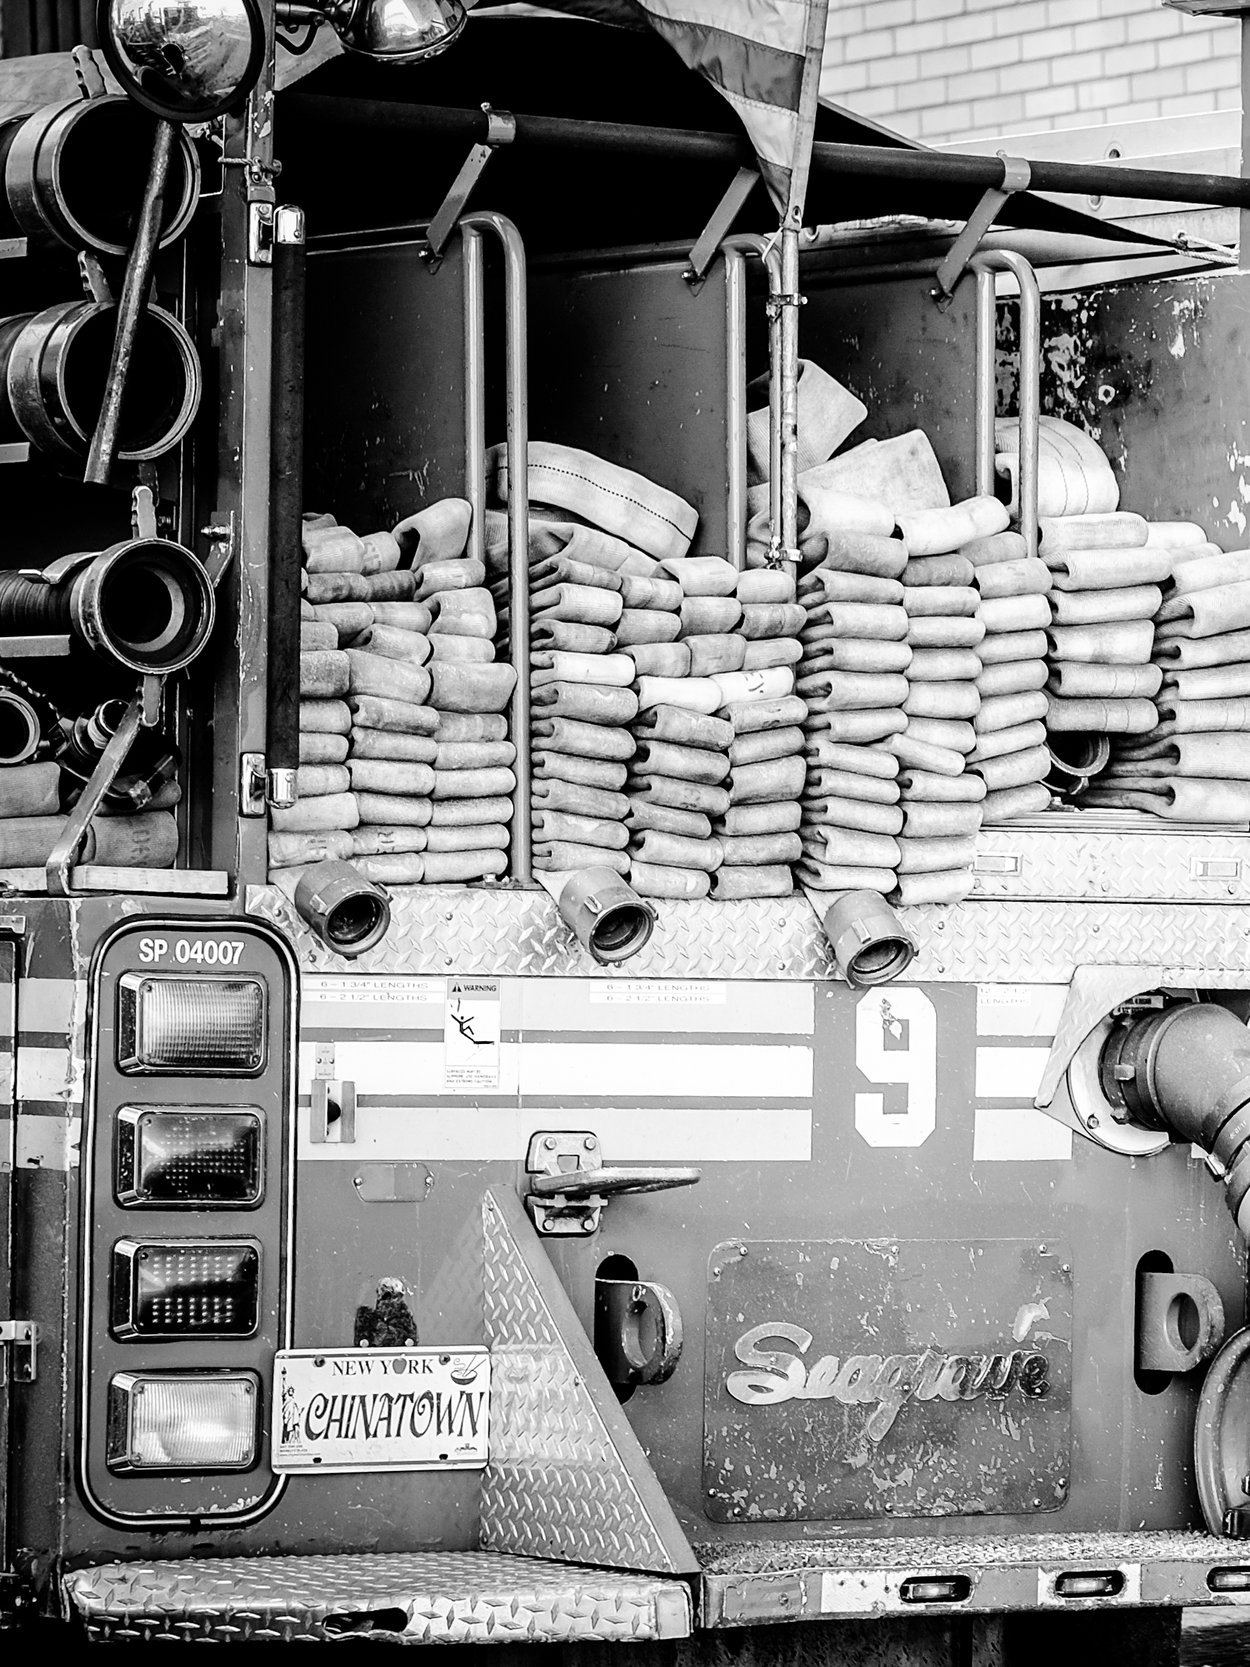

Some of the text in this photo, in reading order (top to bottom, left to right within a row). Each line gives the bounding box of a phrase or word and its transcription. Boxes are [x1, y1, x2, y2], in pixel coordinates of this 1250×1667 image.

[138, 937, 245, 965] SP 04007
[373, 981, 429, 989] LENGTHS
[463, 984, 497, 992] WARNING
[372, 993, 428, 1001] LENGTHS
[854, 986, 937, 1148] 9
[331, 1359, 375, 1376] NEW
[304, 1389, 486, 1441] CHINATOWN
